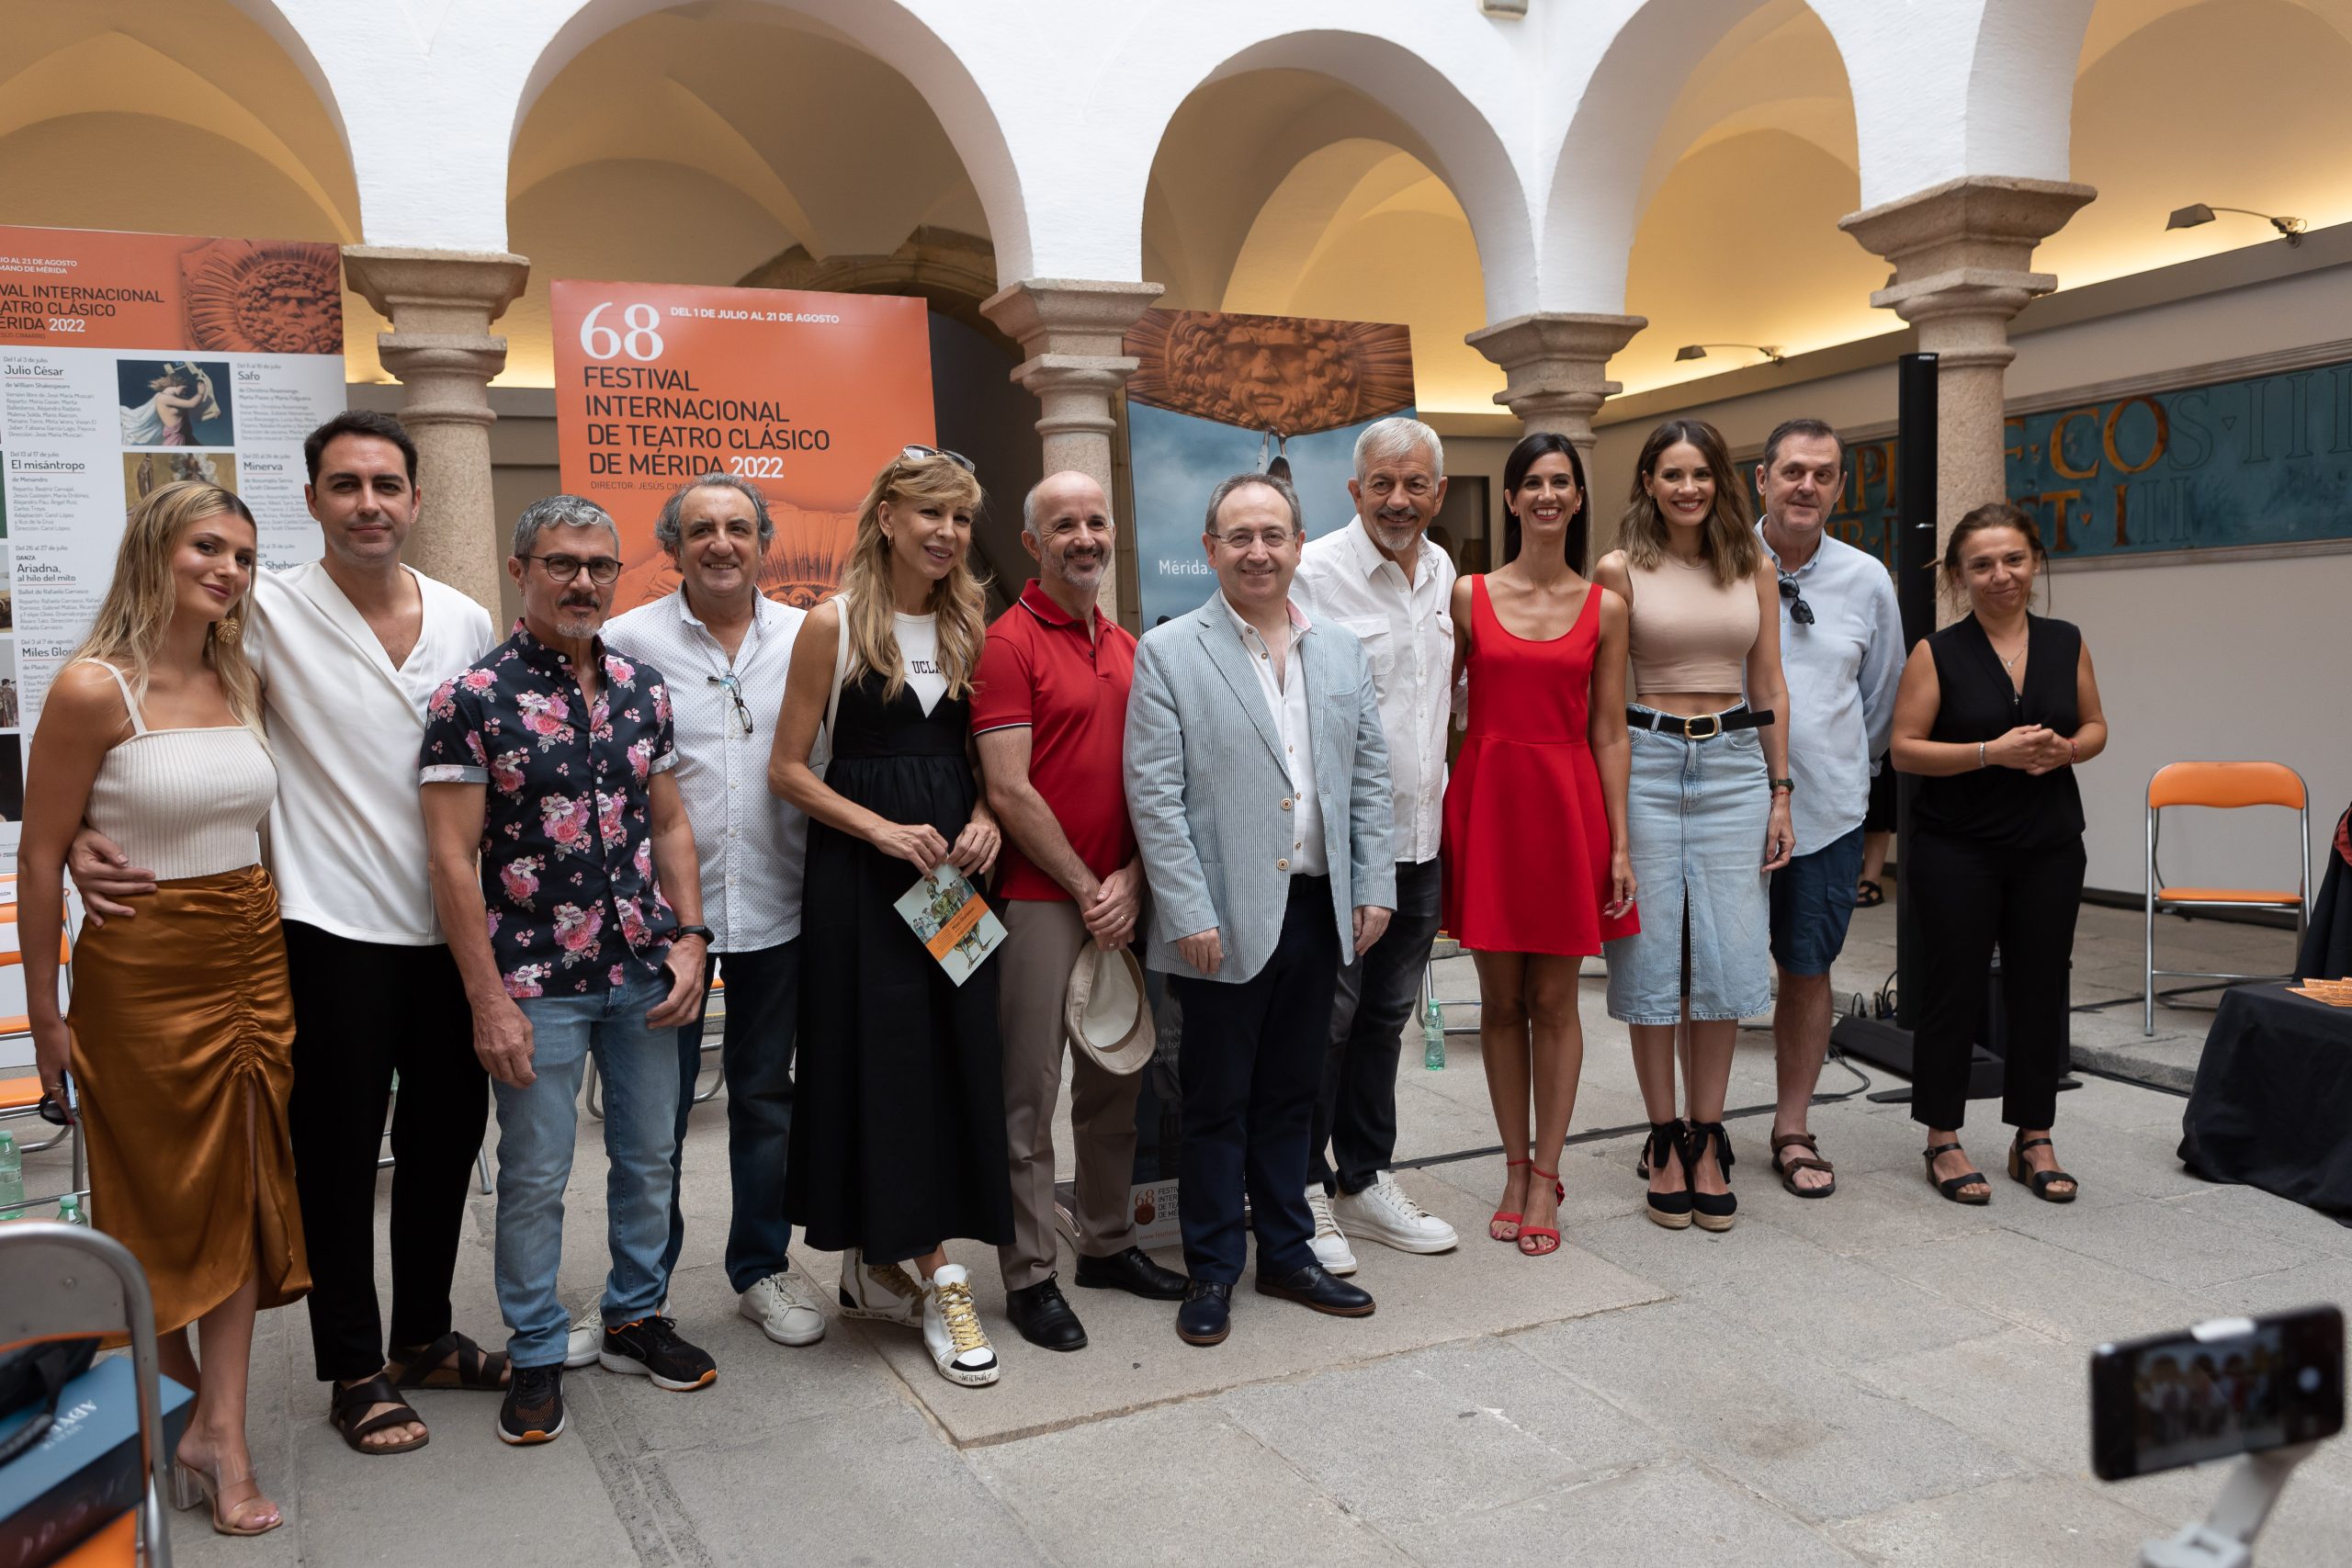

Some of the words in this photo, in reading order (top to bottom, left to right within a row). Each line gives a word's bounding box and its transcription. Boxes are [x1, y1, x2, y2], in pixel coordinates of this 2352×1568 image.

[45, 259, 77, 267] AGOSTO
[33, 286, 164, 303] INTERNACIONAL
[48, 299, 116, 317] CLÁSICO
[671, 307, 692, 317] DEL
[700, 309, 715, 318] DE
[718, 310, 748, 320] JULIO
[751, 311, 764, 321] AL
[766, 312, 777, 321] 21
[779, 312, 794, 321] DE
[795, 313, 840, 323] AGOSTO
[49, 318, 85, 333] 2022
[581, 302, 663, 361] 68
[5, 365, 31, 375] Julio
[34, 366, 64, 376] César
[238, 370, 260, 380] Safo
[584, 367, 699, 391] FESTIVAL
[585, 395, 790, 423] INTERNACIONAL
[587, 423, 621, 446] DE
[626, 425, 722, 449] TEATRO
[729, 423, 830, 450] CLÁSICO
[11, 459, 21, 468] El
[24, 460, 85, 471] misántropo
[243, 462, 283, 471] Minerva
[589, 453, 622, 475] DE
[629, 447, 725, 477] MÉRIDA
[729, 456, 784, 479] 2022
[591, 480, 636, 490] DIRECTOR:
[638, 480, 664, 491] JESÚS
[667, 482, 686, 491] CIM
[17, 563, 62, 574] Ariadna,
[1159, 559, 1212, 575] Mérida.
[22, 648, 50, 657] Miles
[51, 647, 75, 657] Glor
